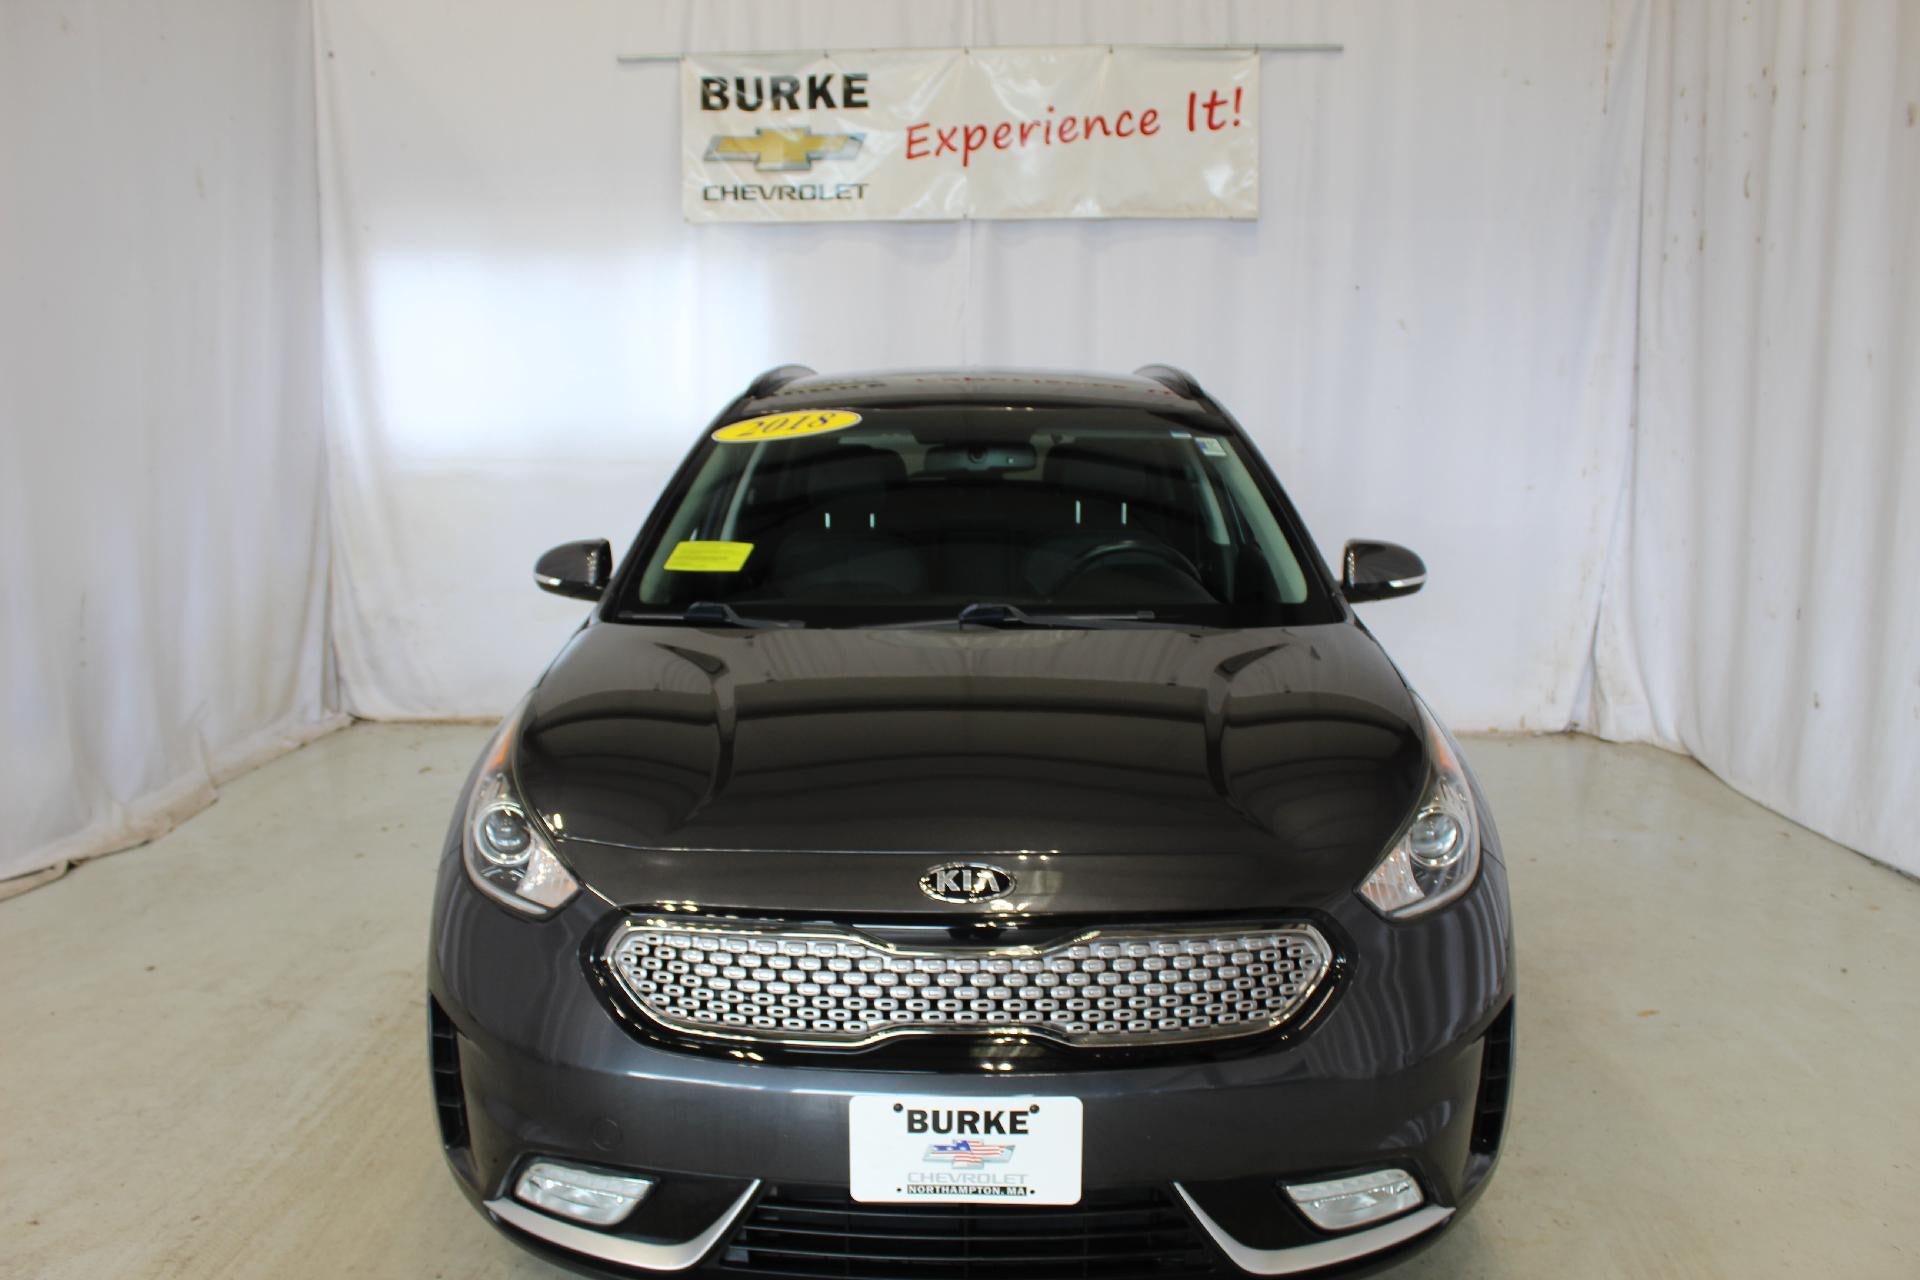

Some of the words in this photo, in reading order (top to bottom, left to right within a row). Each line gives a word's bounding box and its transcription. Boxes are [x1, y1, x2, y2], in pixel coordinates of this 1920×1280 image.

[702, 73, 869, 111] BURKE
[905, 106, 1160, 167] Experience
[1187, 86, 1243, 131] It!
[703, 183, 869, 200] CHEVROLET
[738, 413, 836, 436] 2018
[936, 870, 1000, 892] KIA
[907, 1109, 1029, 1134] BURKE
[907, 1172, 1028, 1184] CHEVROLET
[1007, 1187, 1026, 1196] MA
